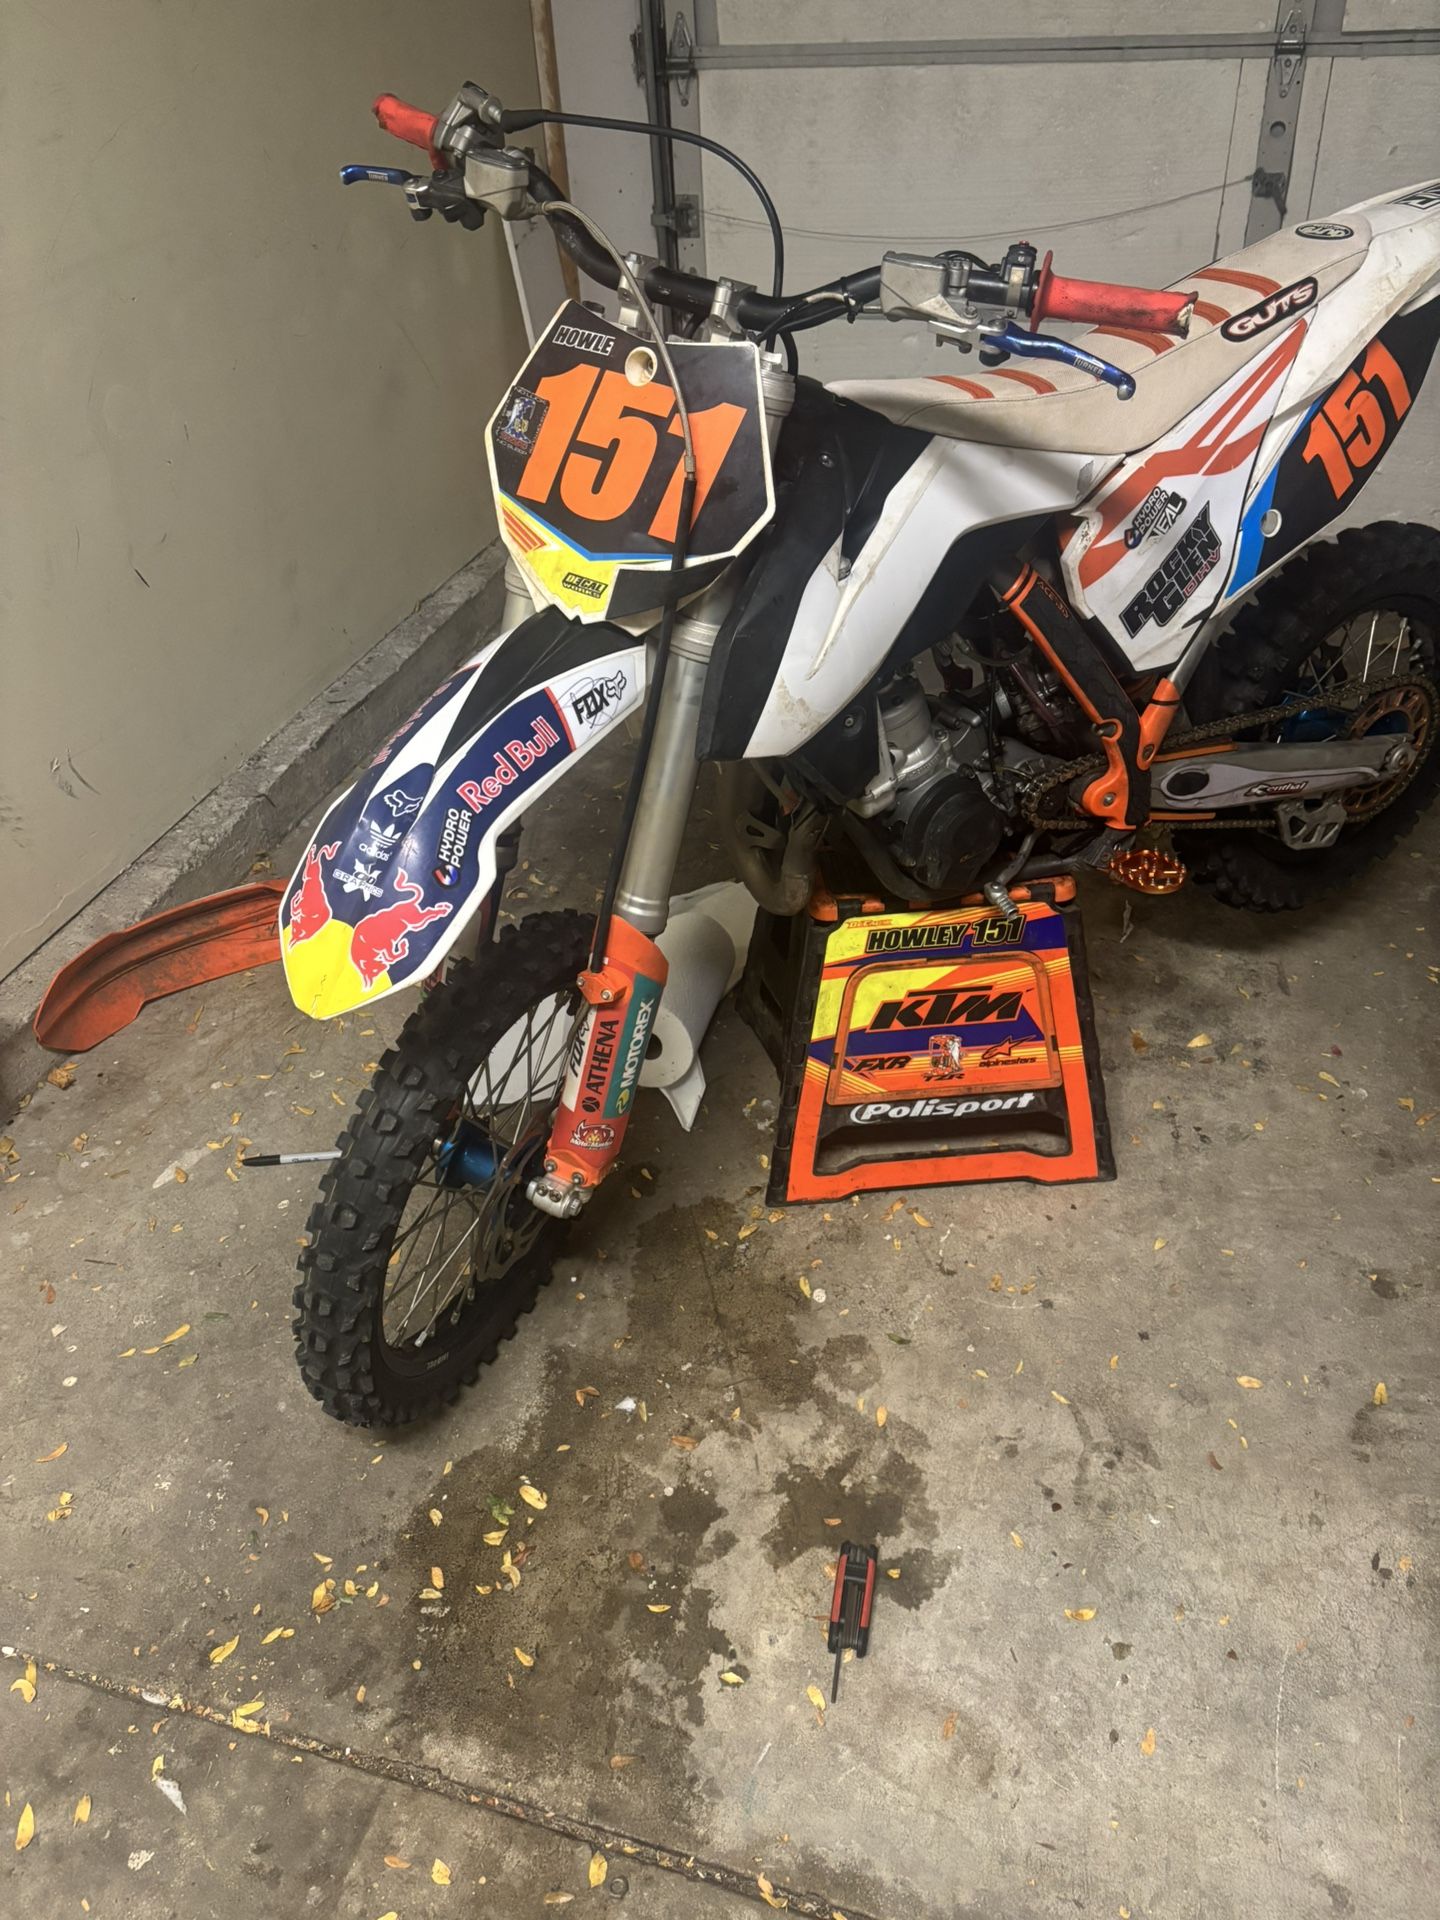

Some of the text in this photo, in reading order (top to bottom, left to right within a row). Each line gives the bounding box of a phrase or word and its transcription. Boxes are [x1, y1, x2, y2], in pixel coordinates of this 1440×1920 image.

[1226, 284, 1316, 337] GUTS
[552, 325, 616, 356] HOWLE
[1303, 338, 1412, 500] 151
[516, 363, 747, 543] 151
[1134, 487, 1161, 528] HYDRO
[1138, 490, 1169, 534] POWER
[564, 573, 607, 592] DECAL
[1119, 500, 1211, 639] ROCKY
[1151, 528, 1222, 628] GLEN
[571, 682, 609, 725] FOX
[456, 758, 518, 813] Red
[503, 715, 560, 772] Bull
[438, 808, 460, 862] HYDRO
[450, 810, 473, 868] POWER
[865, 915, 1027, 953] HOWLEY 151
[868, 985, 1026, 1031] KTM
[589, 1019, 620, 1096] ATHENA
[620, 998, 654, 1089] MOTOREX
[852, 1055, 914, 1073] FXR
[857, 1091, 1035, 1122] Polisport
